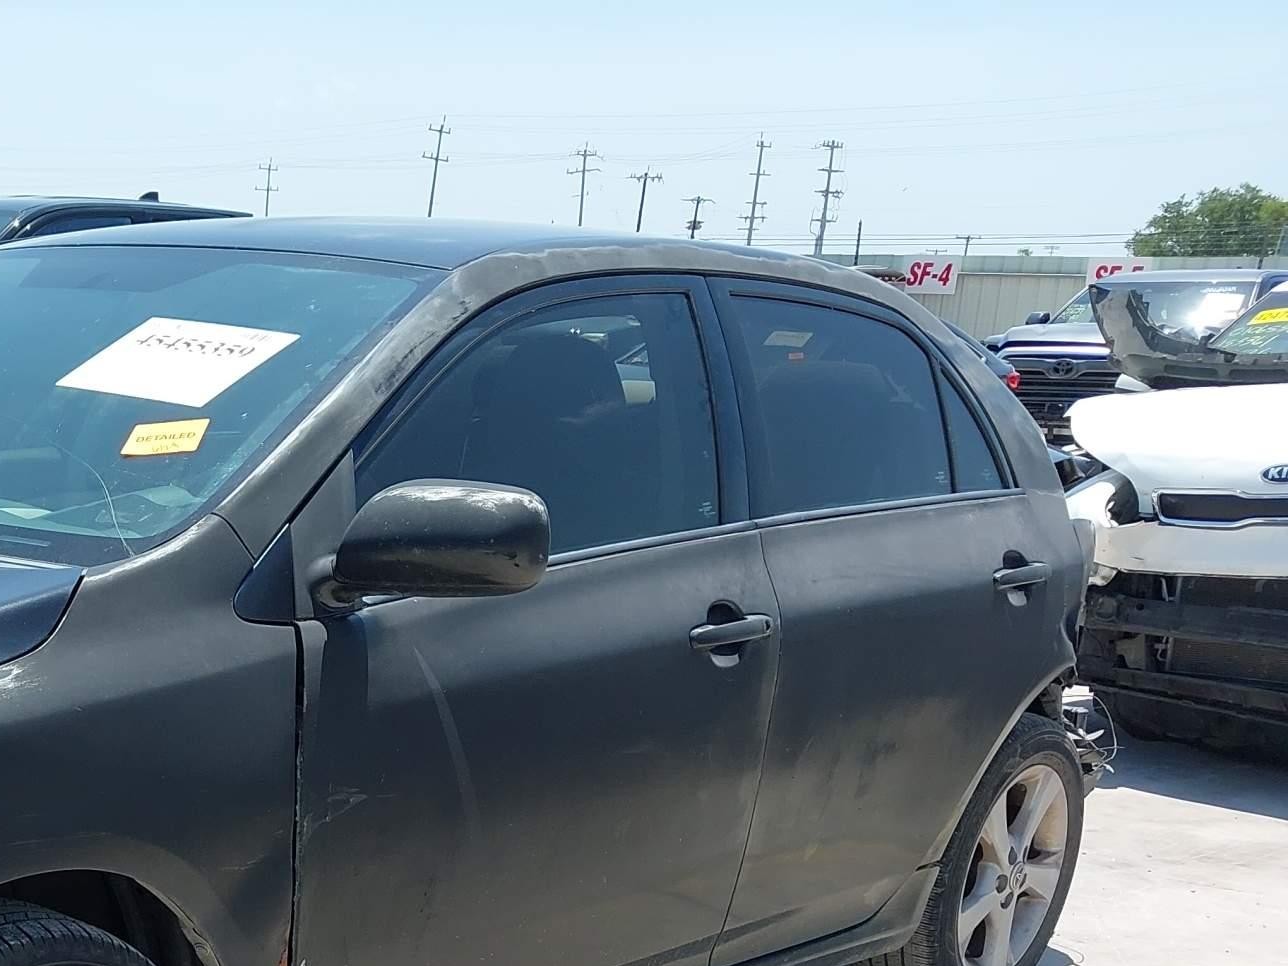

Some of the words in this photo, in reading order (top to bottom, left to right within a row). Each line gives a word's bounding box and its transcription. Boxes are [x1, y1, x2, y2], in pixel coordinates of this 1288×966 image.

[906, 261, 953, 286] SF-4
[135, 431, 196, 443] DETAILED
[1267, 467, 1288, 480] KI
